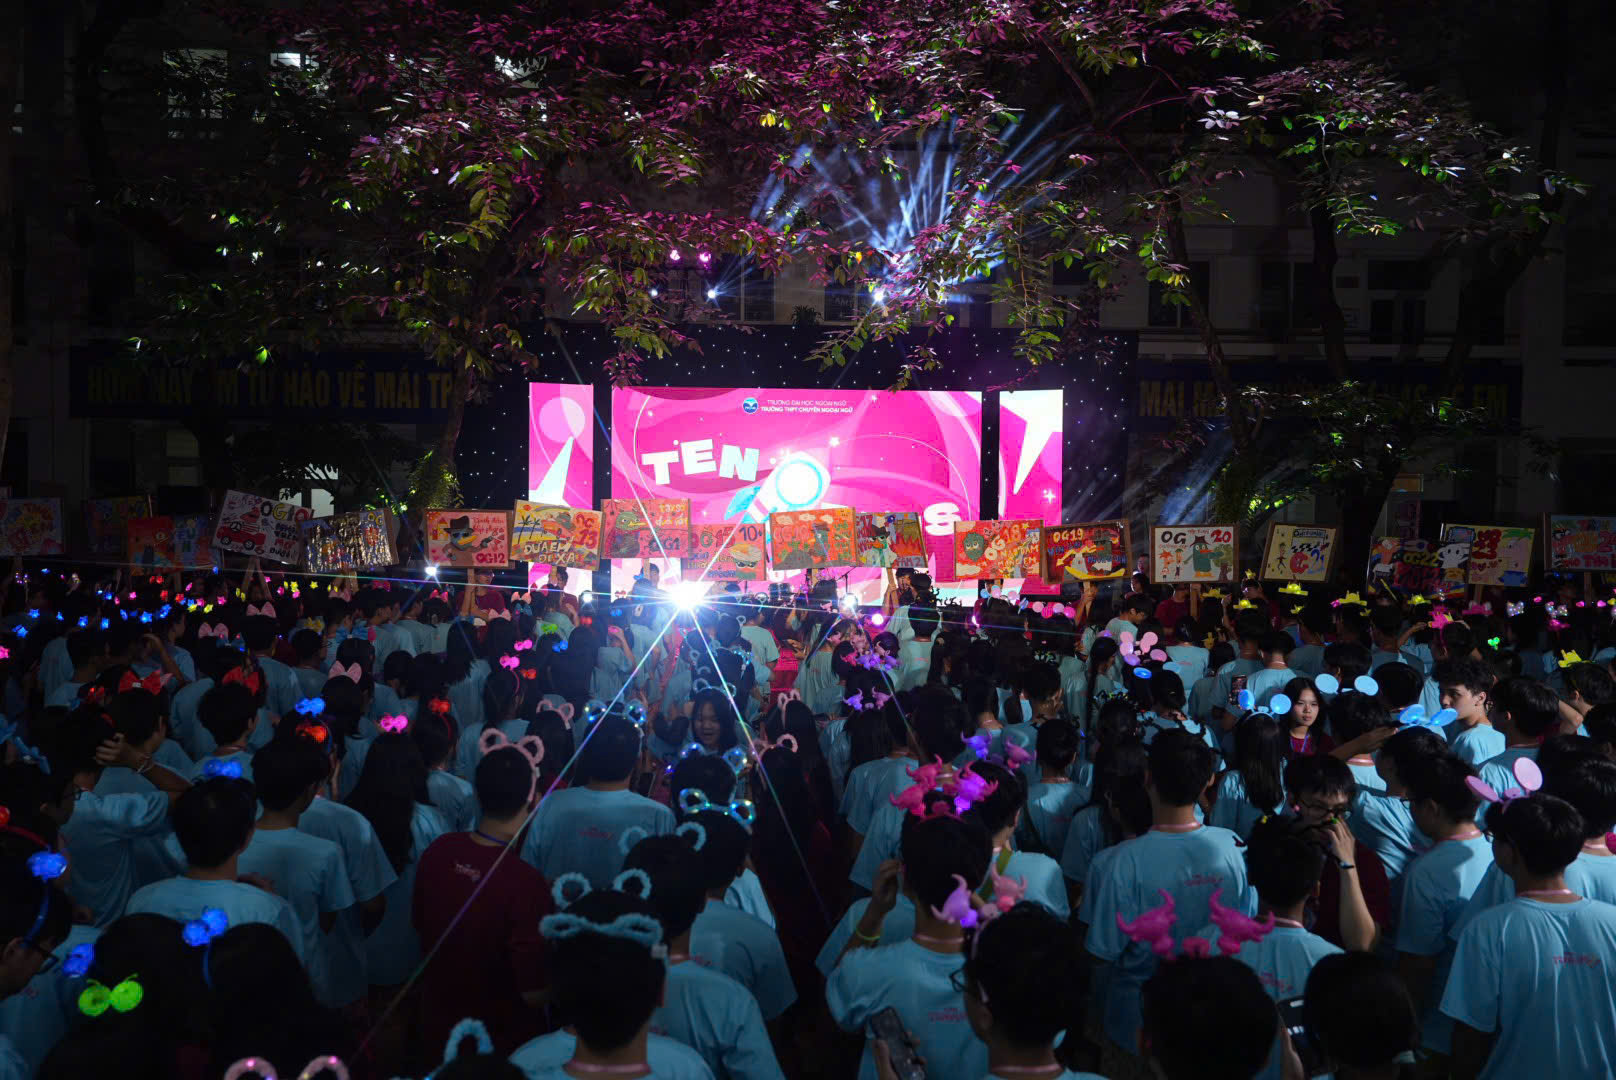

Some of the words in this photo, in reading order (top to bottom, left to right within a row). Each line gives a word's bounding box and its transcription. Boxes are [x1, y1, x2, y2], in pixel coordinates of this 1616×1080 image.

[1053, 528, 1084, 541] OG19
[1160, 531, 1188, 545] OG
[1210, 529, 1232, 544] 20
